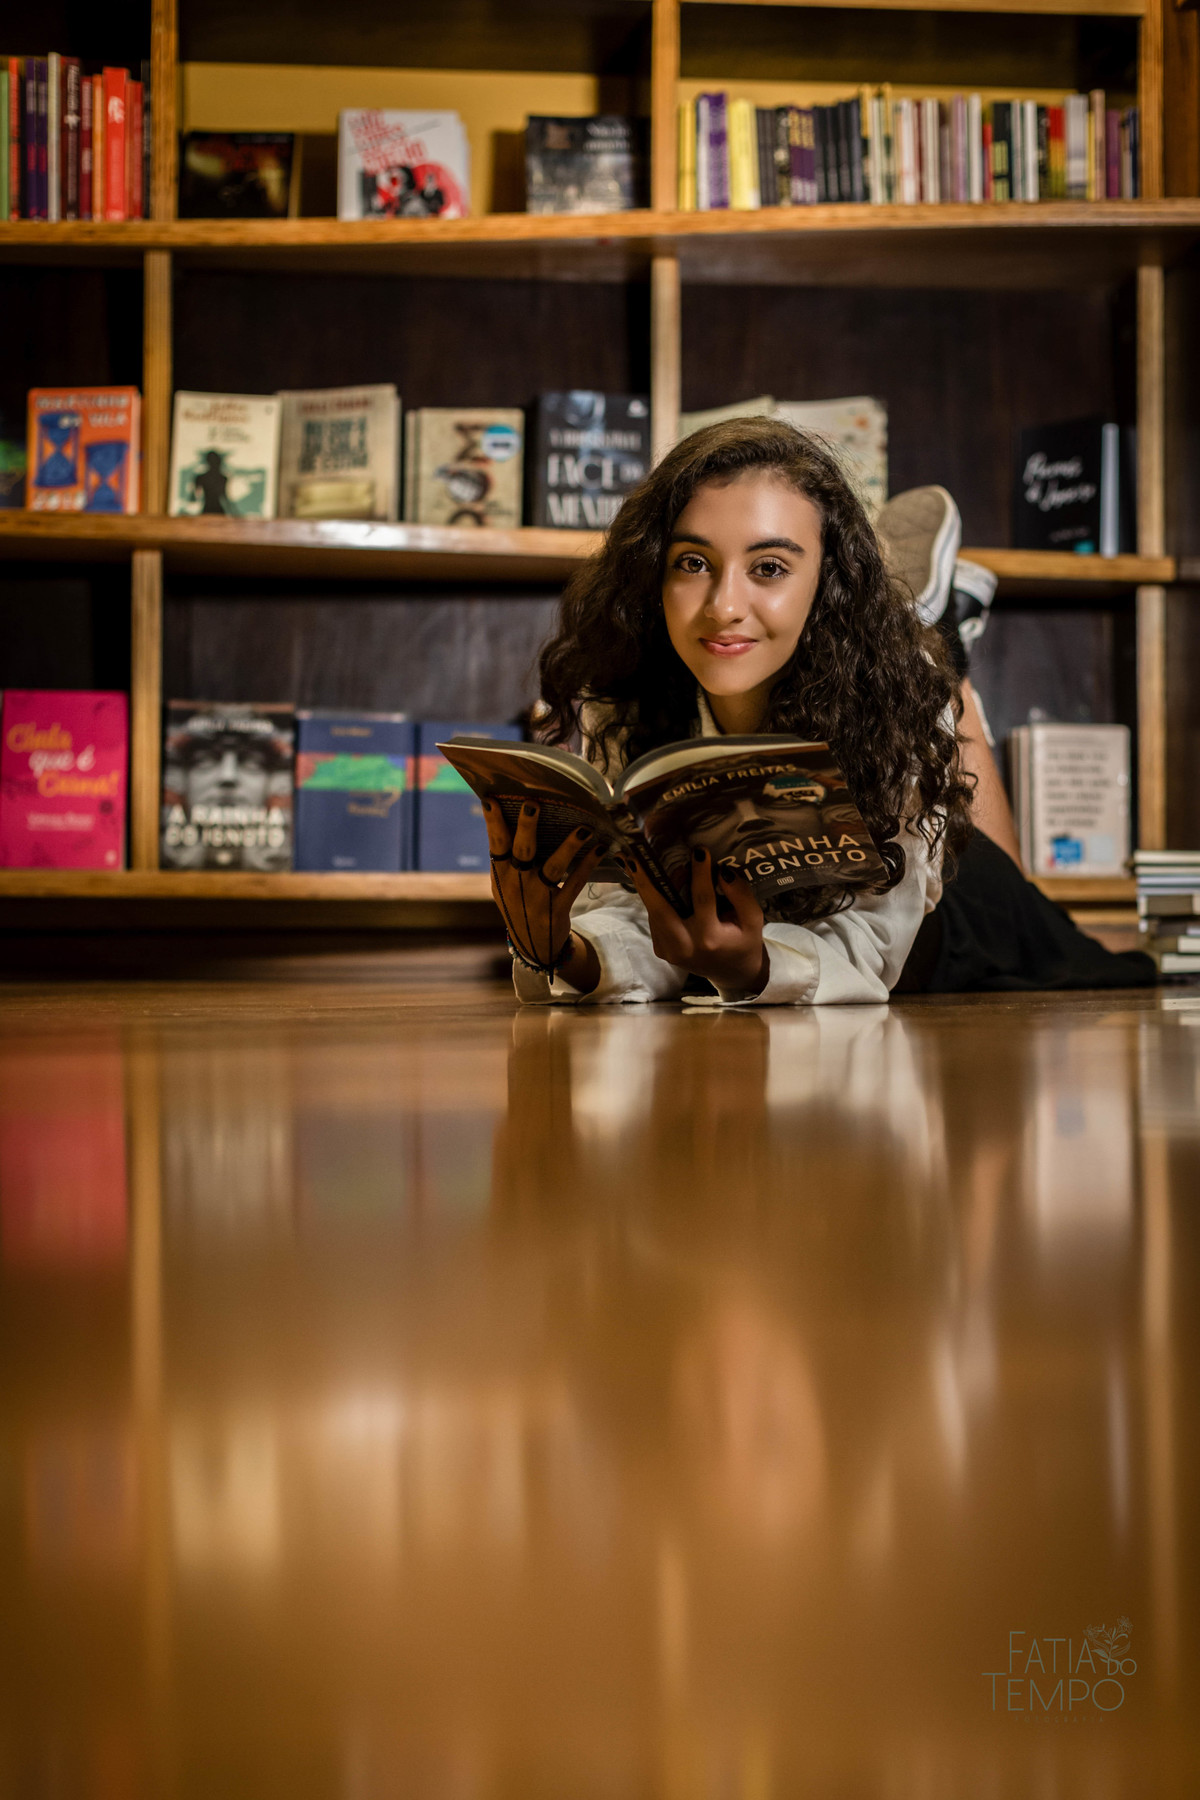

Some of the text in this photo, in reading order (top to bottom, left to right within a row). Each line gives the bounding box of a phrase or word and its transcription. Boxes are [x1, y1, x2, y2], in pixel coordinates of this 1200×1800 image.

[547, 453, 615, 490] FACE
[29, 744, 95, 778] que é
[662, 763, 797, 801] EMÍLIA FREITAS
[191, 805, 285, 826] RAINHA
[202, 825, 285, 848] IGNOTO
[717, 833, 861, 868] RAINHA
[744, 849, 867, 881] IGNOTO
